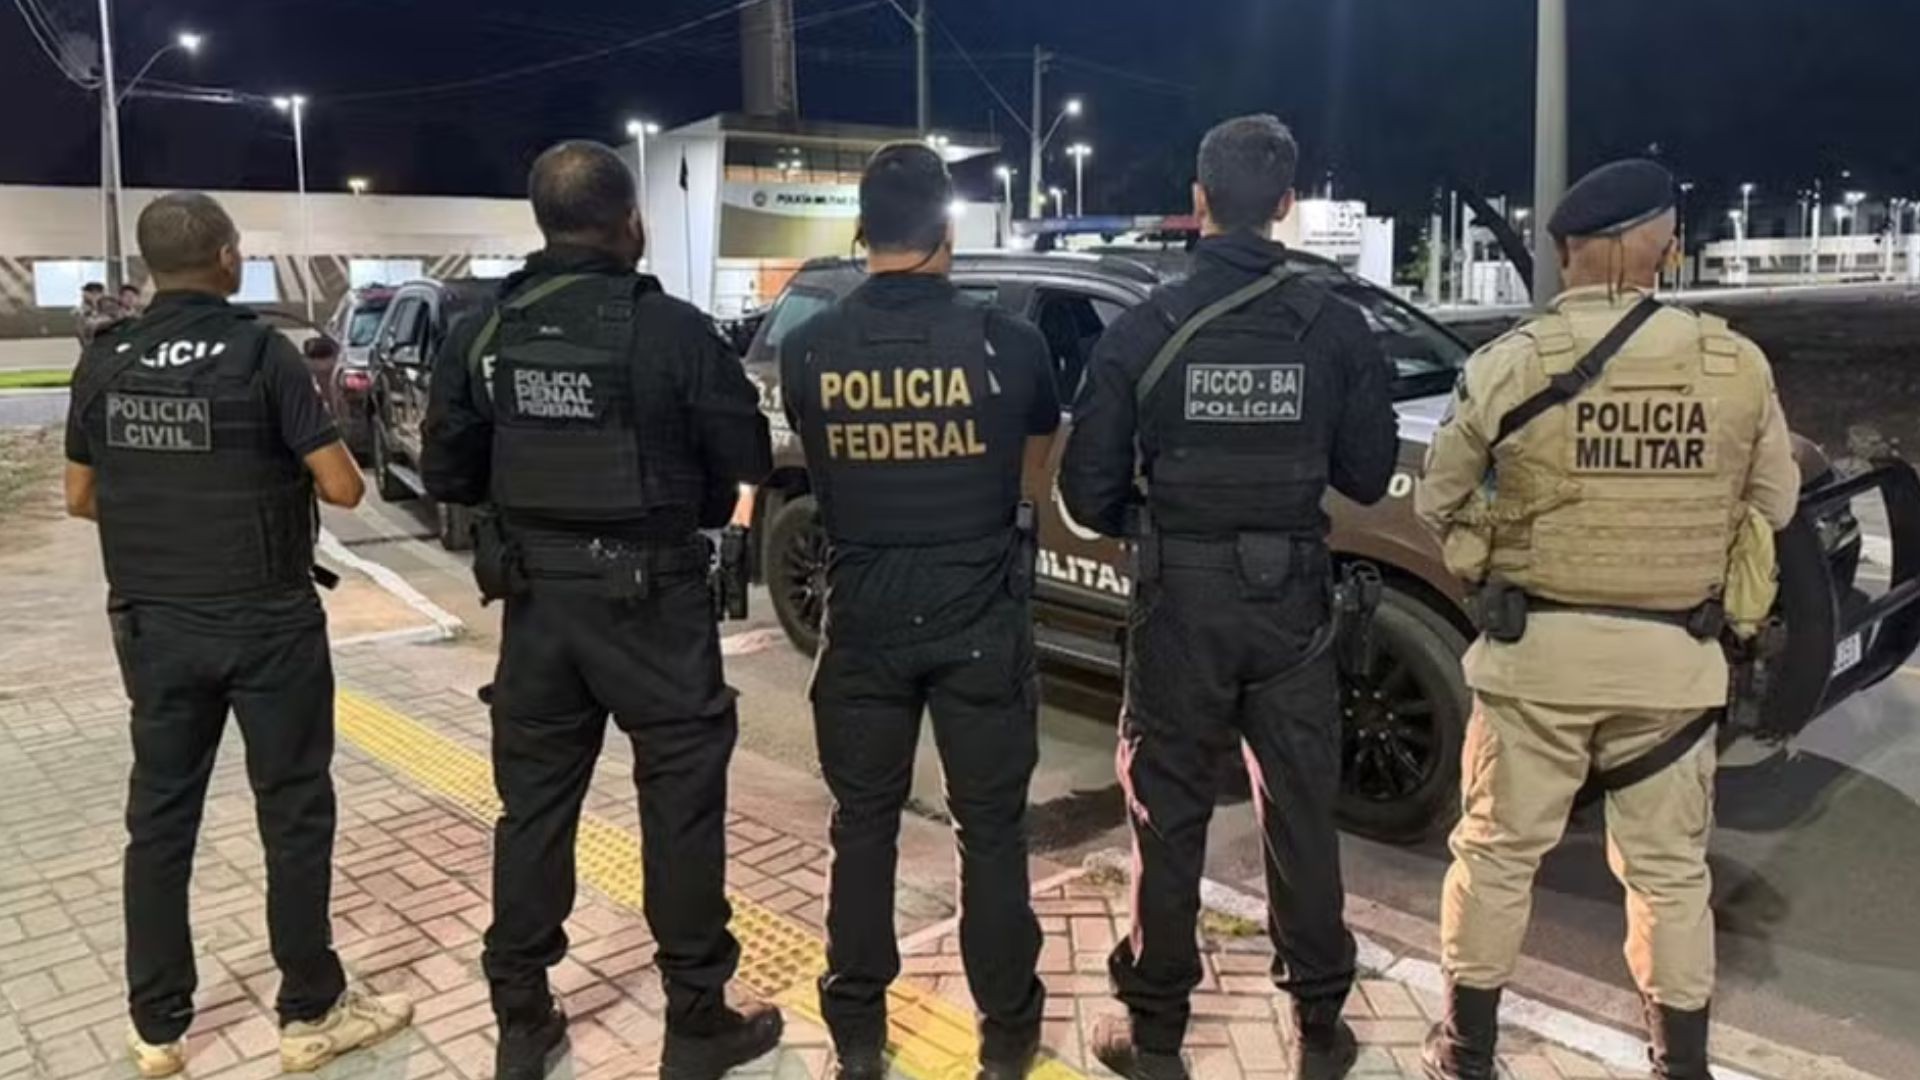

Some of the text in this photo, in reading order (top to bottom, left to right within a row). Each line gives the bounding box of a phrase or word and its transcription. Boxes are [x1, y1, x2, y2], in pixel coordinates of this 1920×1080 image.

[1191, 369, 1253, 395] FICCO
[1270, 369, 1297, 395] BA
[1576, 397, 1707, 434] POLÍCIA
[124, 423, 192, 447] CIVIL
[826, 419, 987, 460] FEDERAL
[1575, 437, 1706, 469] MILITAR
